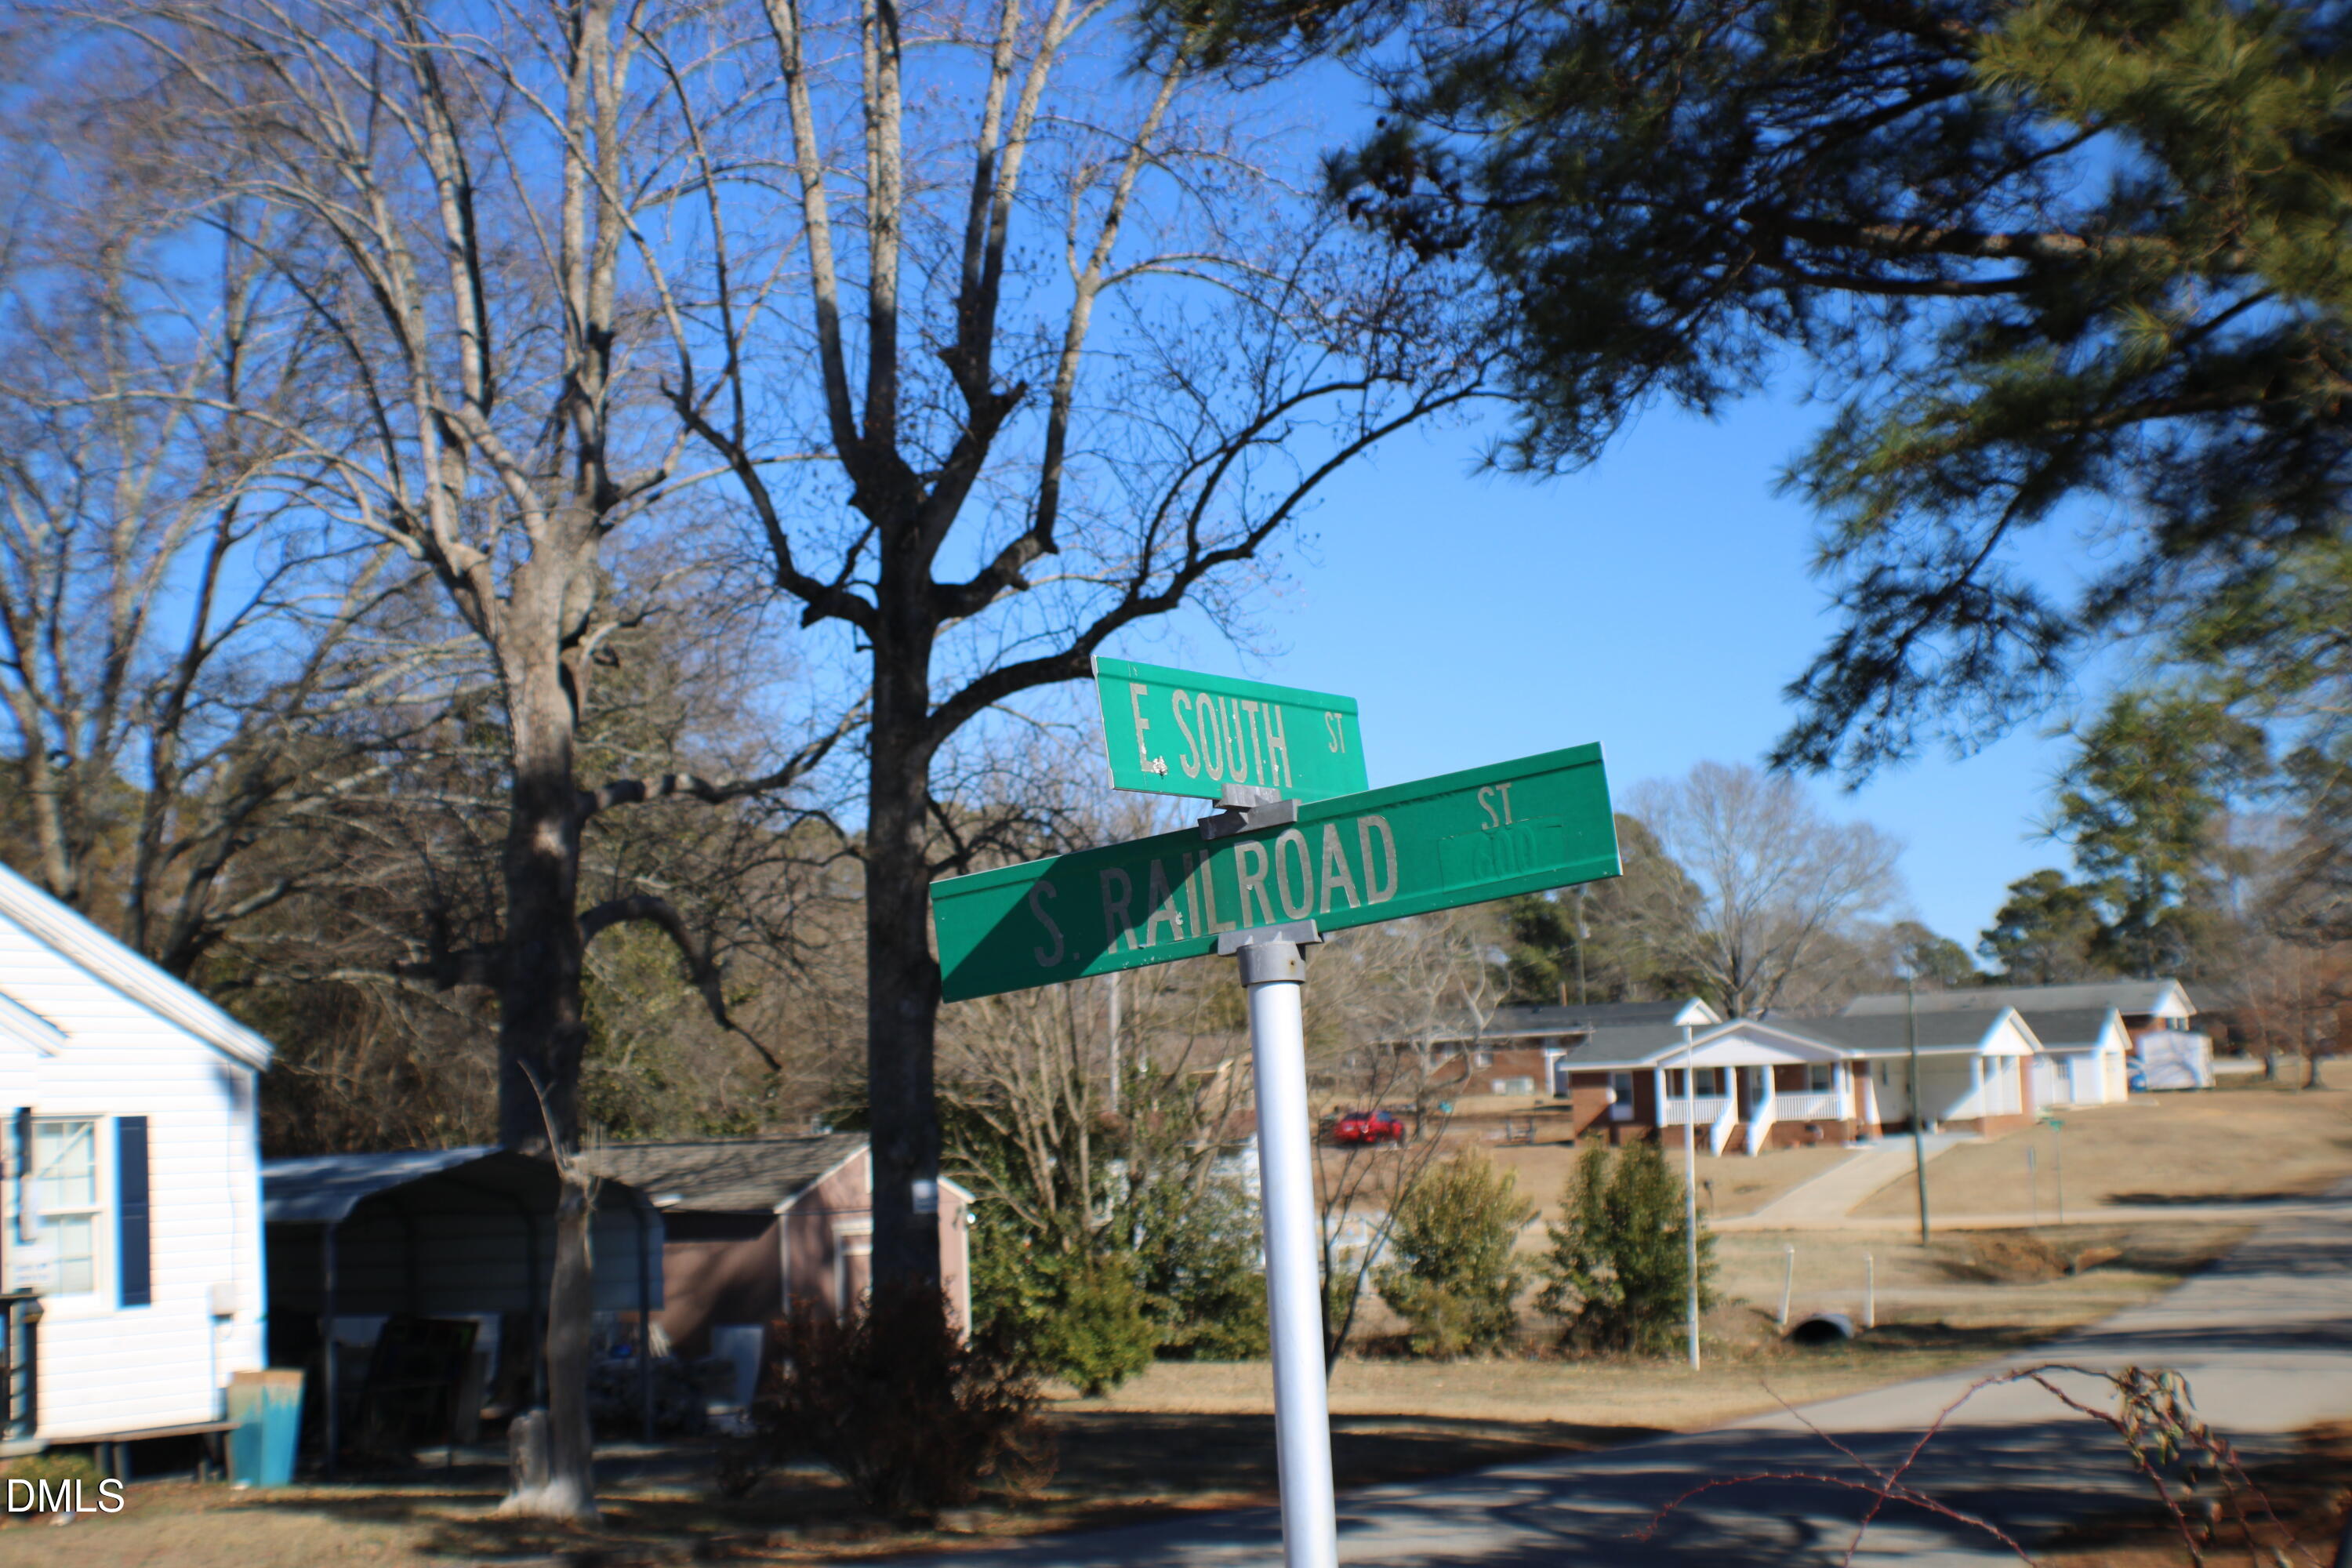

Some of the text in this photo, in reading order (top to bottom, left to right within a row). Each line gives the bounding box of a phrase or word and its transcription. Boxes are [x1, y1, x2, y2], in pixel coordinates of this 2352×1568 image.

[1172, 688, 1293, 789] SOUTH
[1323, 711, 1346, 753] ST
[1100, 815, 1398, 954] RAILROAD
[1477, 782, 1512, 830] ST
